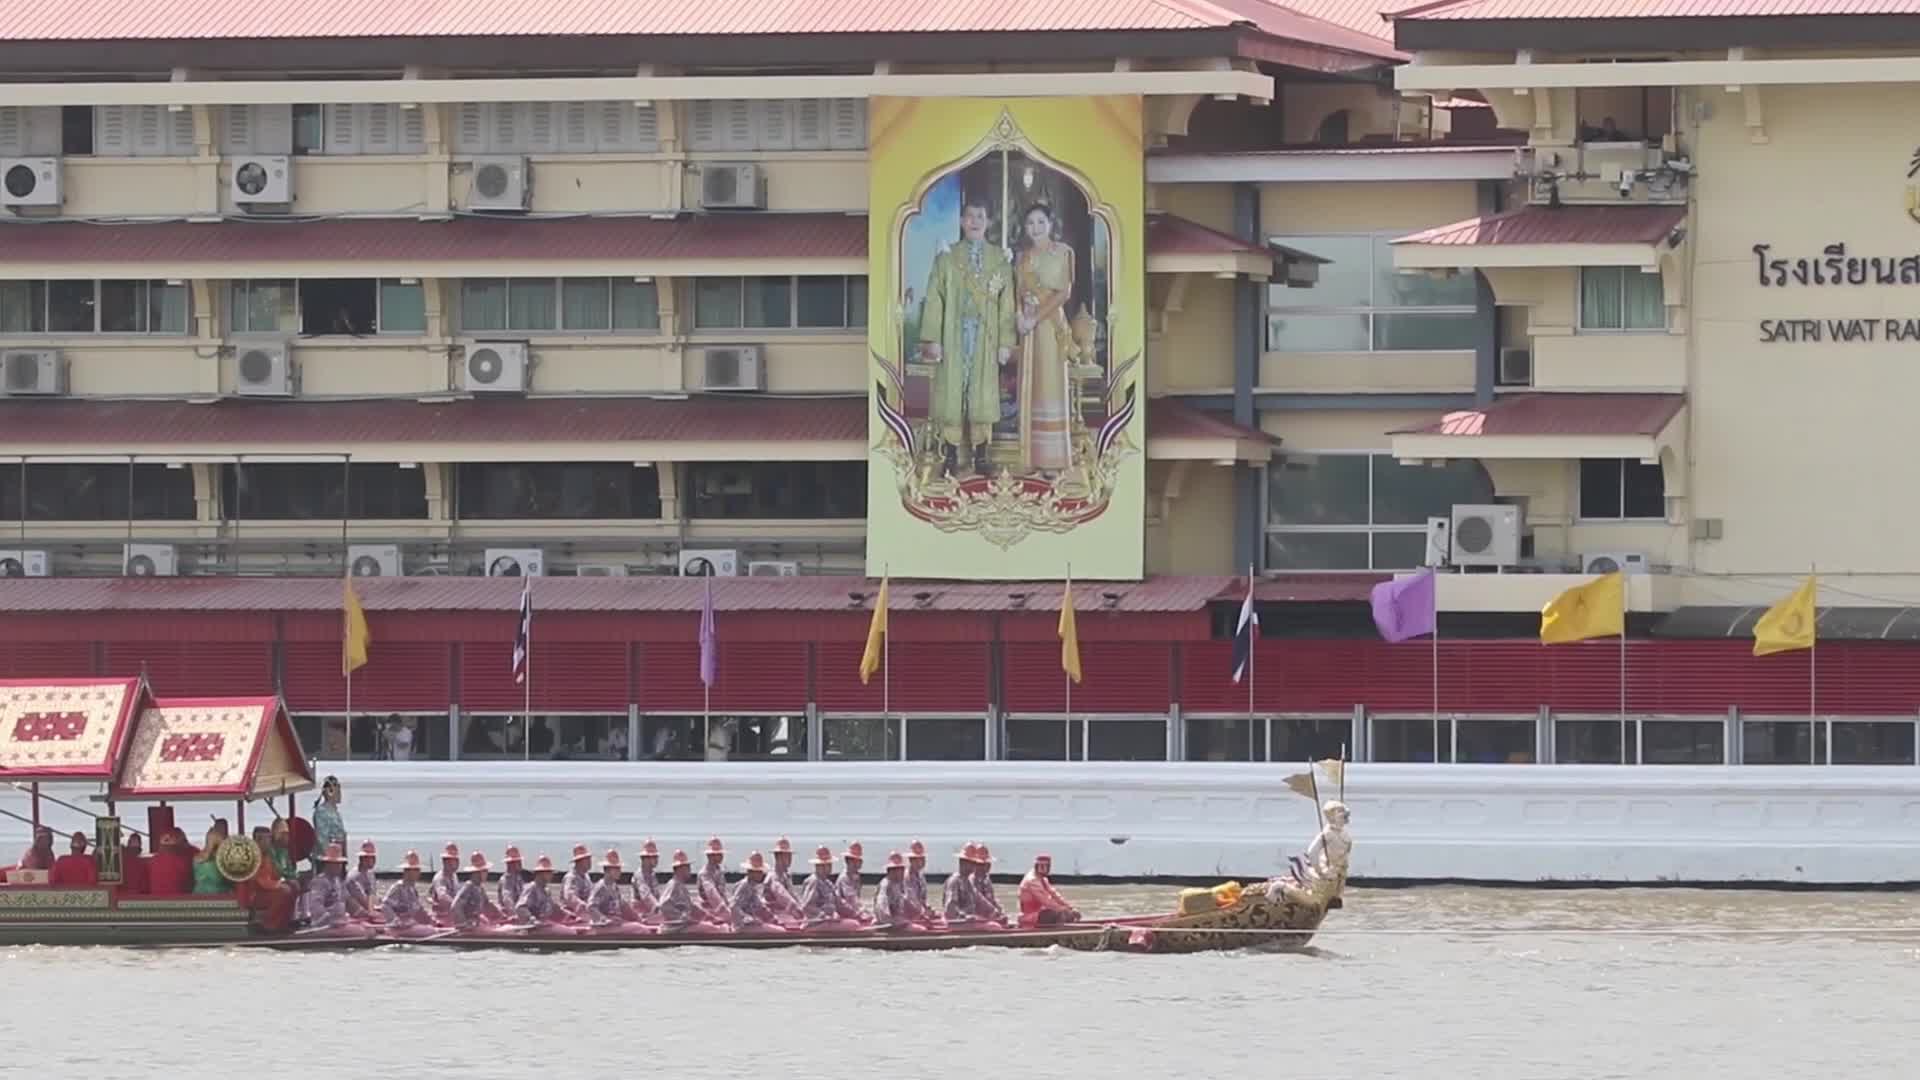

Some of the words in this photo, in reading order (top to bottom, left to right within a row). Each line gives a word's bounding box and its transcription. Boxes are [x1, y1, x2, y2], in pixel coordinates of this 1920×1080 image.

[1760, 319, 1821, 342] SATRI
[1828, 319, 1880, 341] WAT
[1886, 319, 1920, 341] RA
